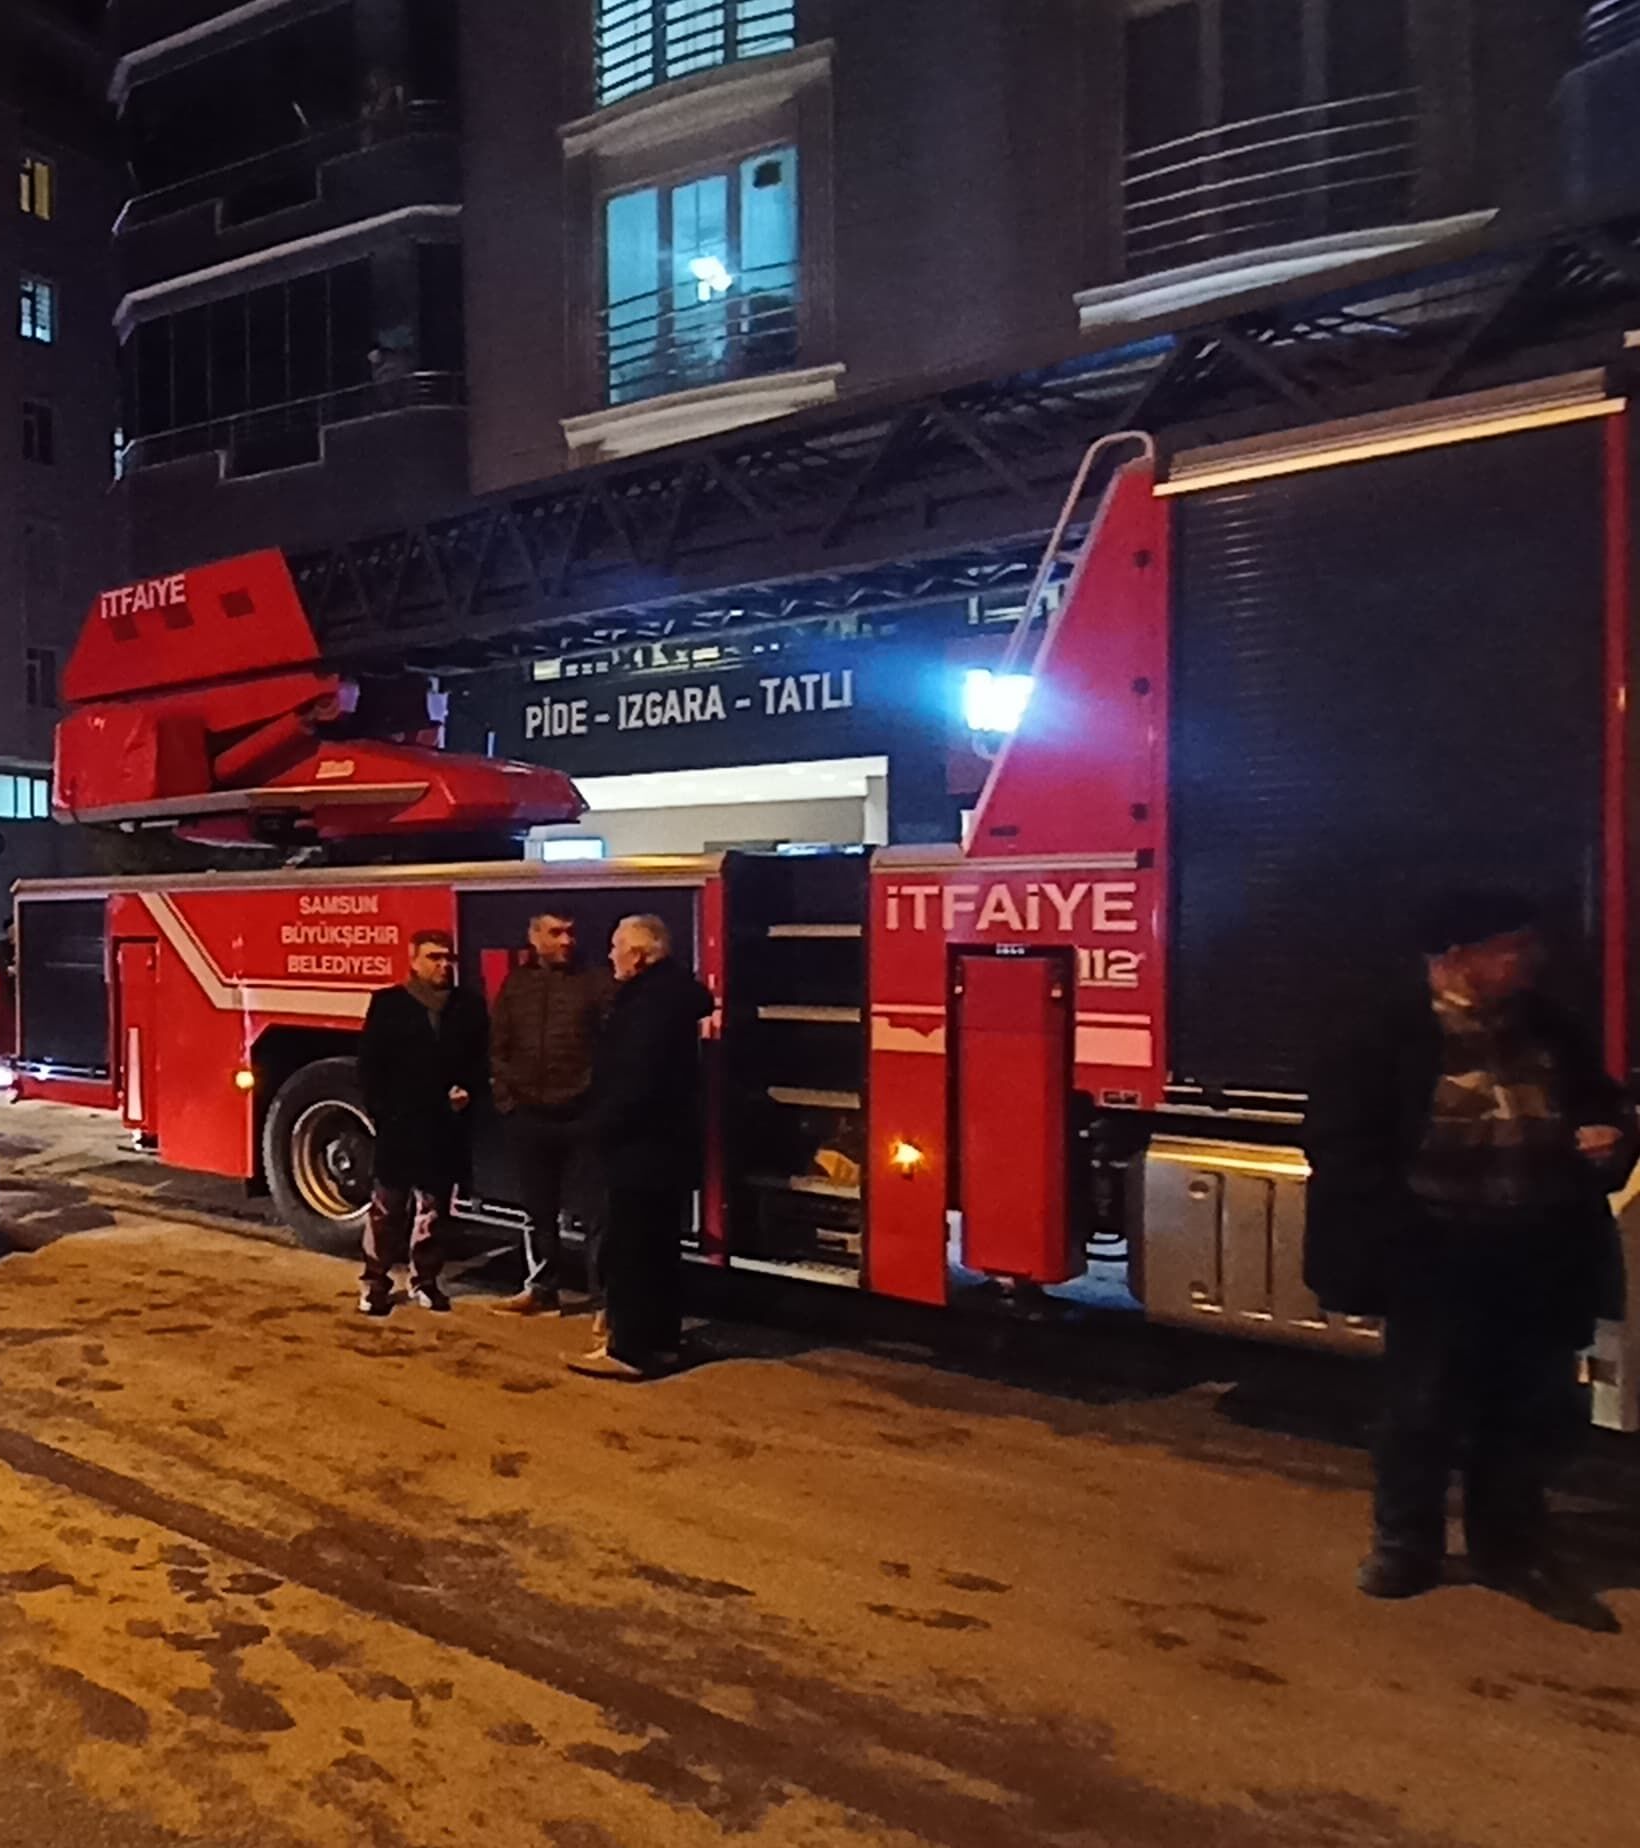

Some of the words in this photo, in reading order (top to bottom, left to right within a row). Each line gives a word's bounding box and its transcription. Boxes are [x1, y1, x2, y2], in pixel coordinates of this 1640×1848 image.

[525, 697, 589, 740] PİDE
[617, 685, 727, 732] IZGARA
[760, 669, 853, 716] TATLI
[299, 895, 379, 915] SAMSUN
[1078, 948, 1139, 982] 112
